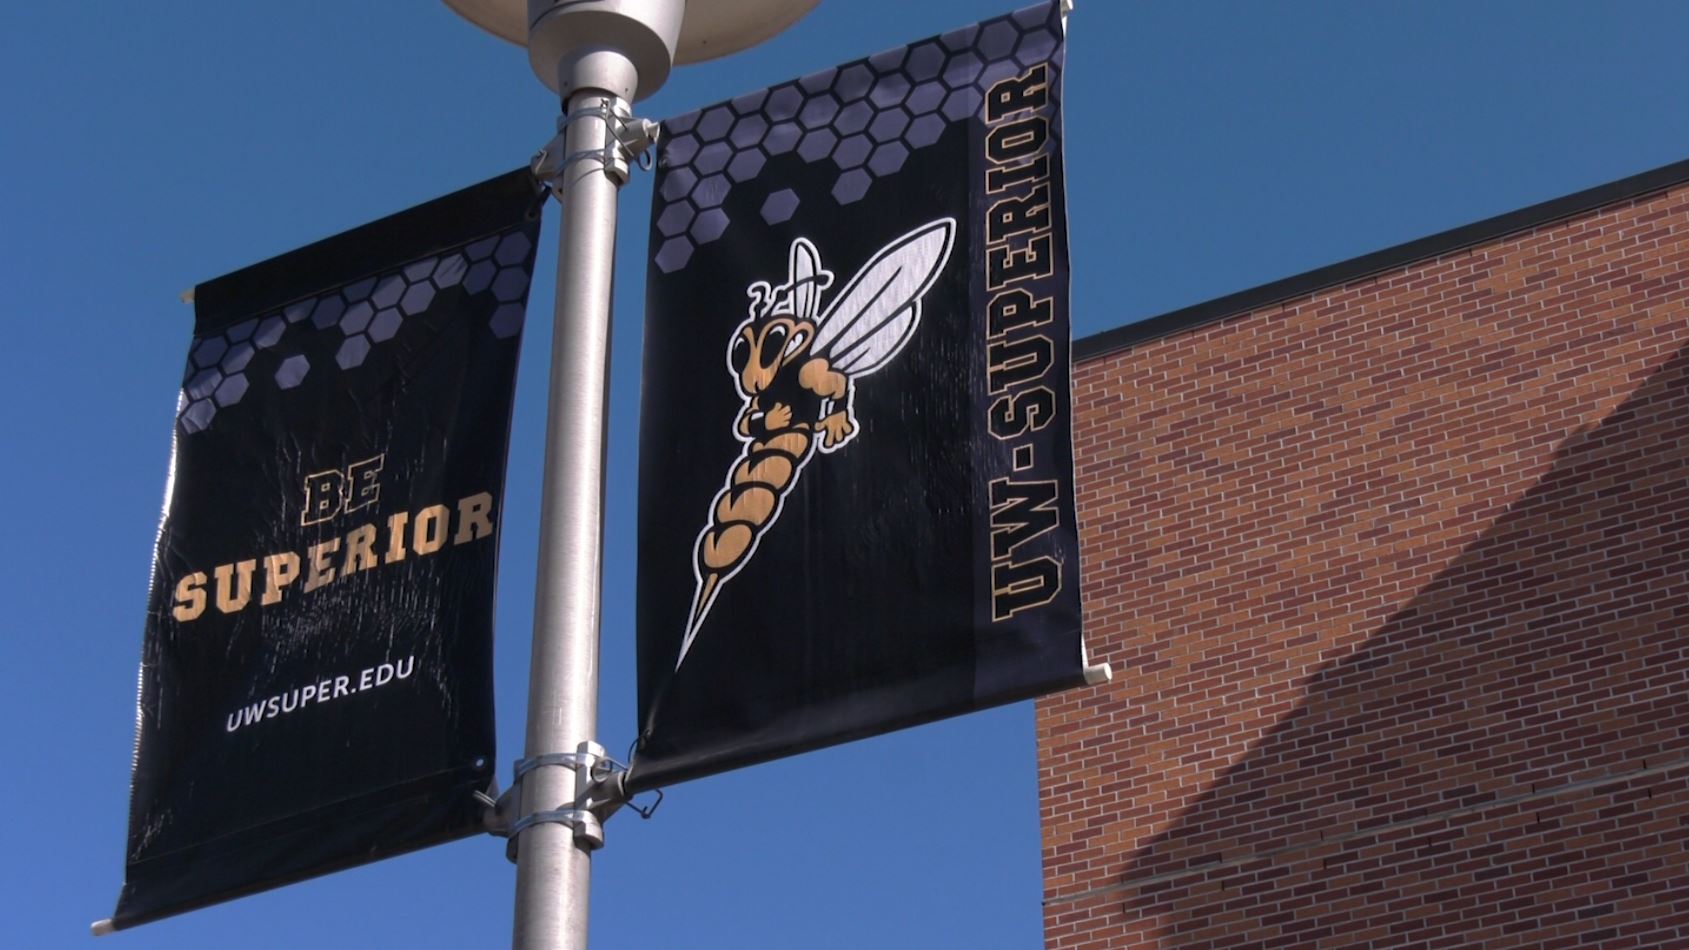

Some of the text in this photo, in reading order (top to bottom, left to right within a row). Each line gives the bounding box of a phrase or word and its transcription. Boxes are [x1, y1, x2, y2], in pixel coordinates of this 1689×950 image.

[985, 62, 1062, 622] UW-SUPERIOR
[301, 453, 386, 526] BE
[172, 491, 493, 622] SUPERIOR
[225, 656, 415, 732] UWSUPER.EDU
